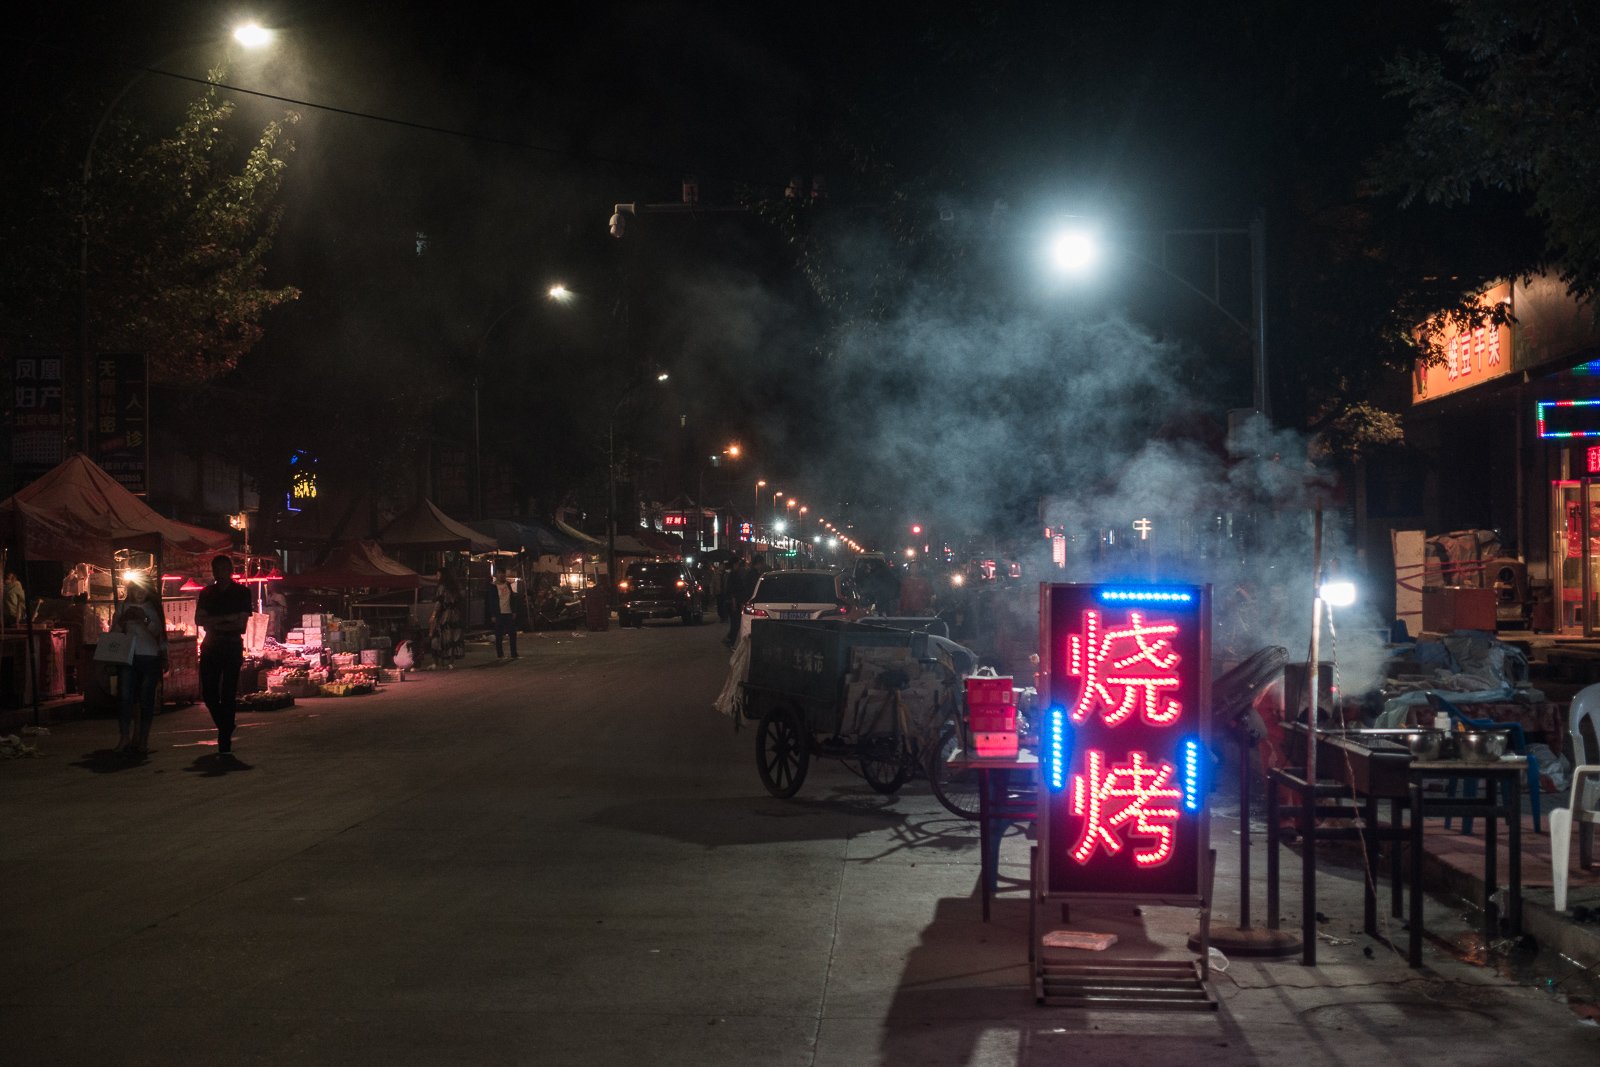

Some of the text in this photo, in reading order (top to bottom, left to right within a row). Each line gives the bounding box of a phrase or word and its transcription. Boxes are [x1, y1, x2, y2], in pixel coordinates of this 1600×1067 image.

[15, 358, 61, 380] 凤凰
[15, 385, 62, 409] 妇产
[1068, 609, 1182, 867] 烧烤
